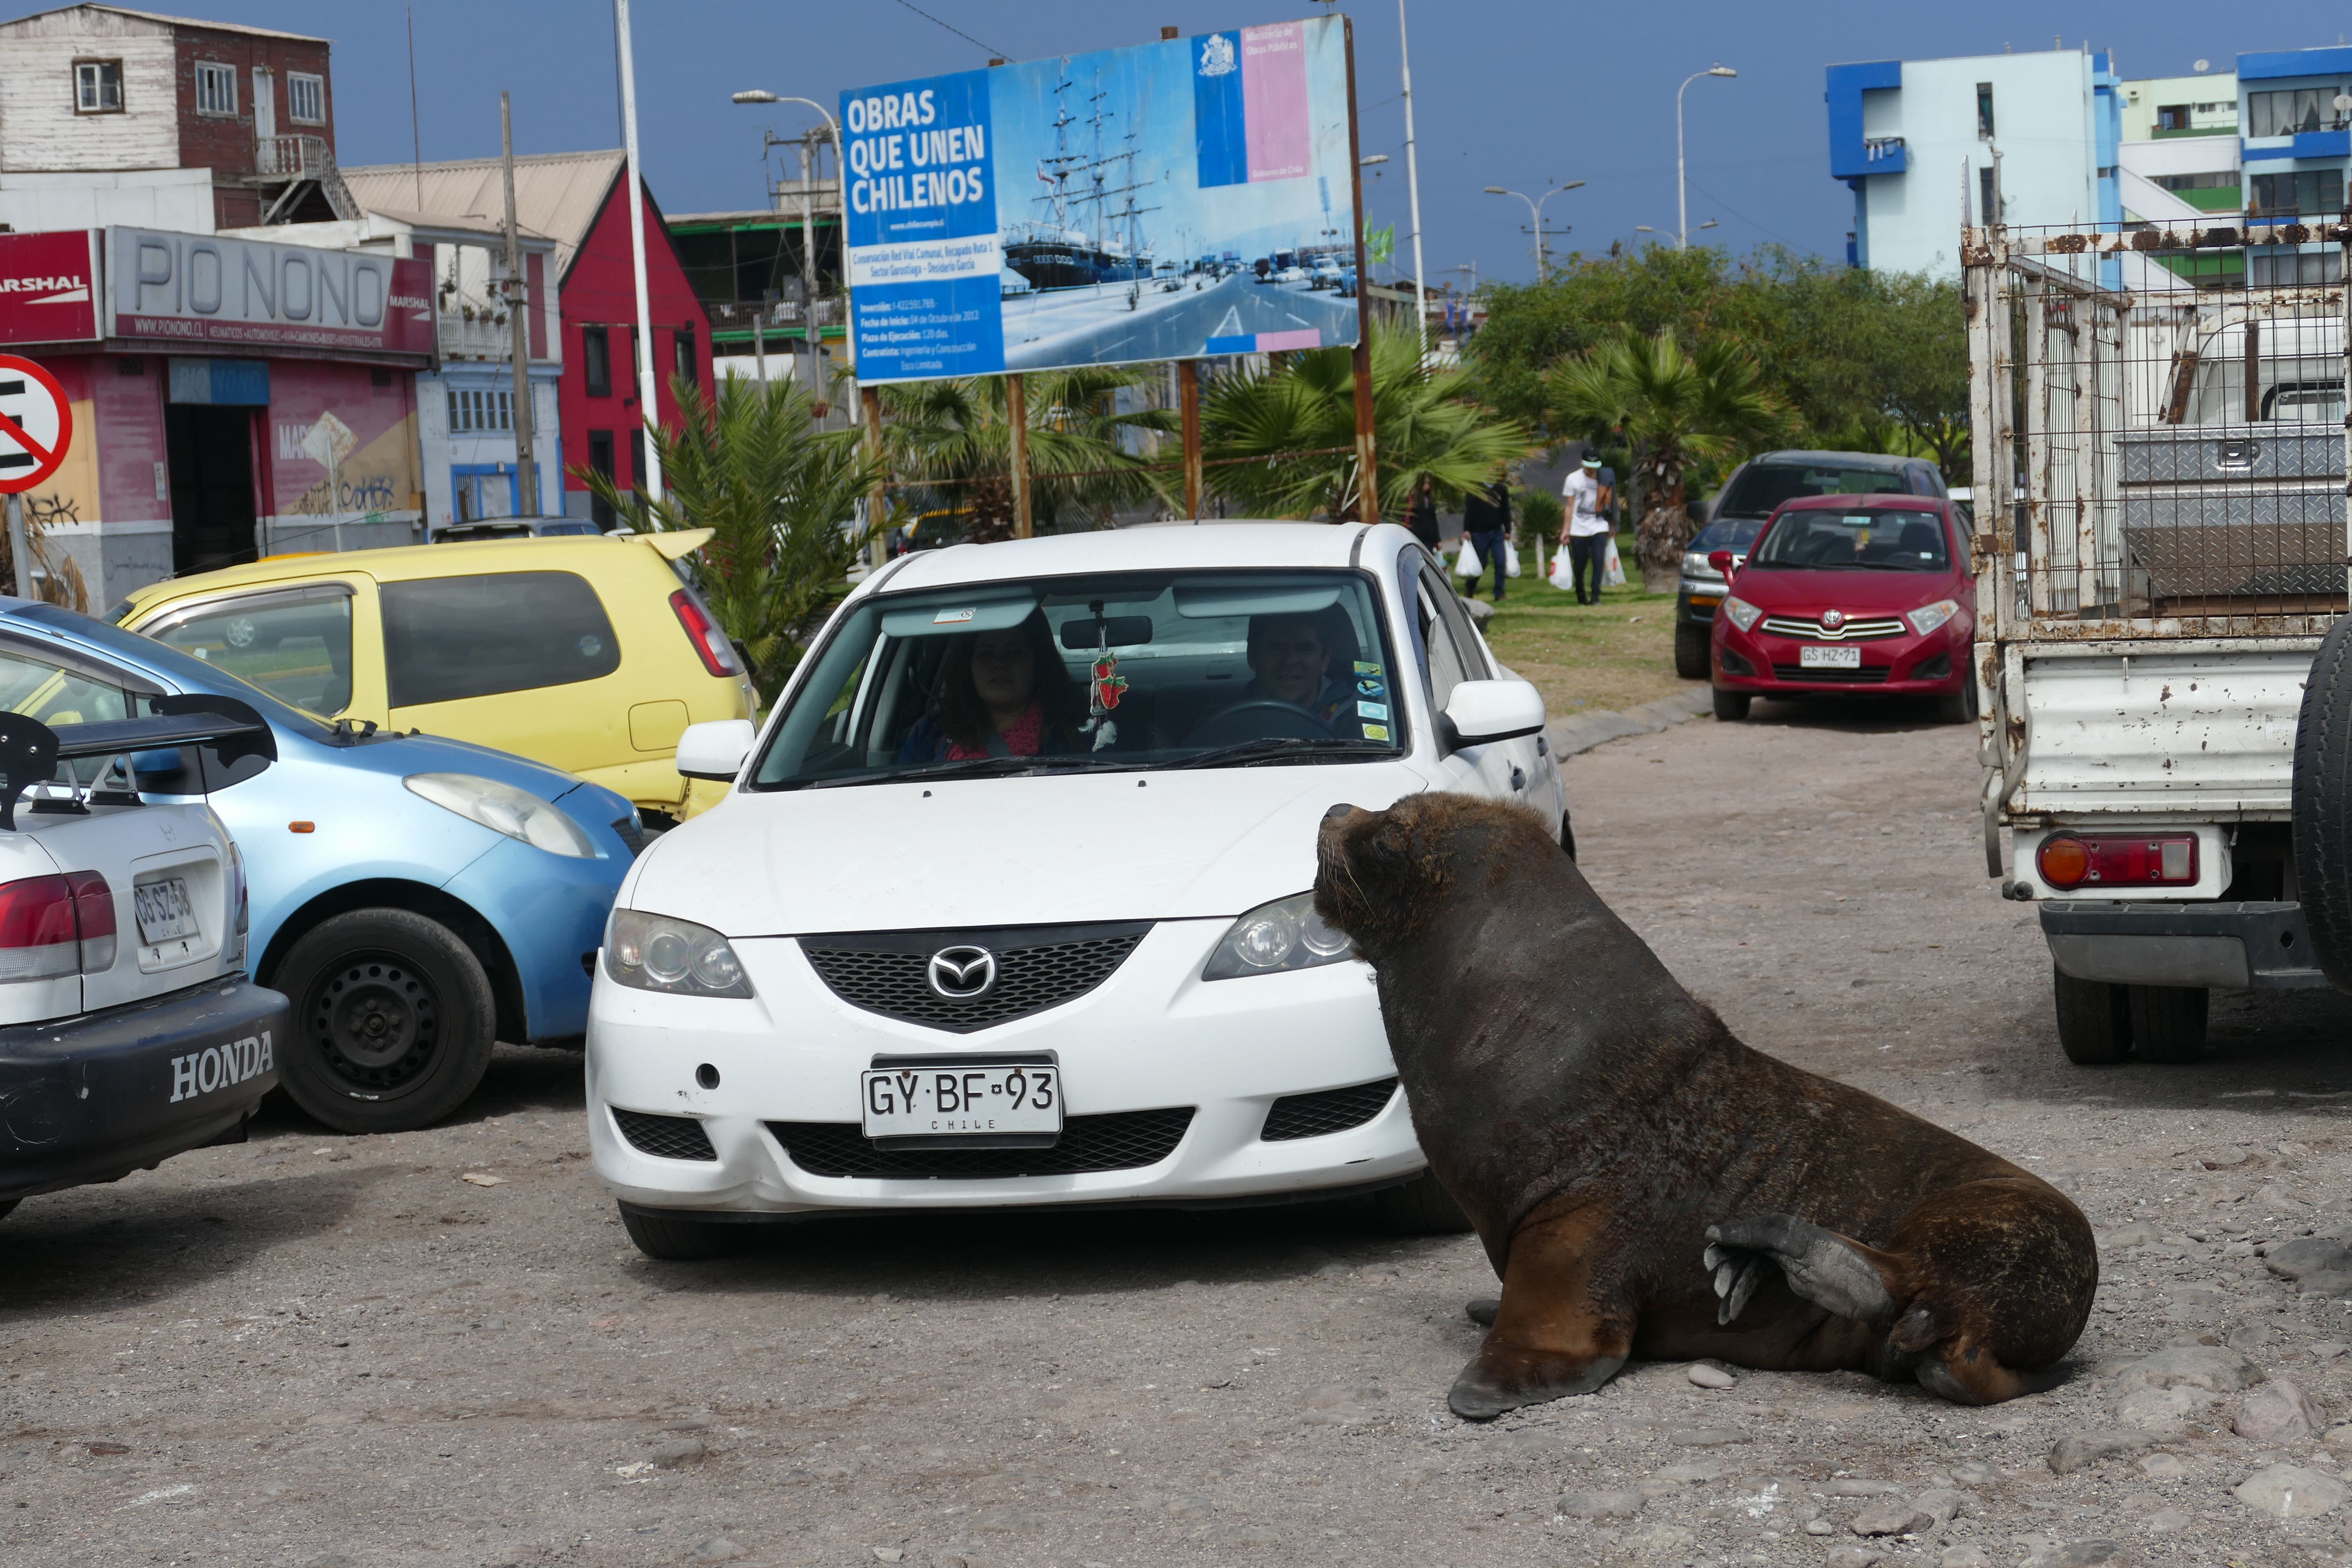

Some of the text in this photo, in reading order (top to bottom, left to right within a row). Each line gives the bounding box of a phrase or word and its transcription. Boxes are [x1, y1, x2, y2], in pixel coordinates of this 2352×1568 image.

[1246, 27, 1293, 41] Ministerio de
[1246, 46, 1267, 55] Obras
[848, 89, 935, 133] OBRAS
[850, 125, 984, 178] QUE UNEN
[852, 166, 983, 213] CHILENOS
[853, 242, 992, 264] Conservación Red Vial Comunal, Recapado Ruta 1
[870, 266, 888, 277] Sector
[890, 263, 921, 277] Gorostiaga
[928, 260, 955, 273] Desiderio
[956, 258, 975, 270] García
[0, 275, 88, 293] RSHAL
[135, 235, 382, 326] PIO NONO
[389, 295, 430, 309] MARSHAL
[860, 301, 891, 313] Inversión:
[135, 318, 204, 337] WWW.PIONONO.CL
[861, 310, 979, 328] Fecha de Inicio: 04 de Octubre de 2012
[209, 326, 243, 339] NEUMATICOS
[861, 333, 879, 343] Plazo
[879, 332, 887, 341] de
[888, 330, 921, 343] Ejecución:
[922, 329, 935, 339] 120
[862, 347, 900, 358] Contratista:
[916, 359, 943, 370] Limitada
[170, 1030, 274, 1103] HONDA
[931, 1119, 995, 1130] CHILE
